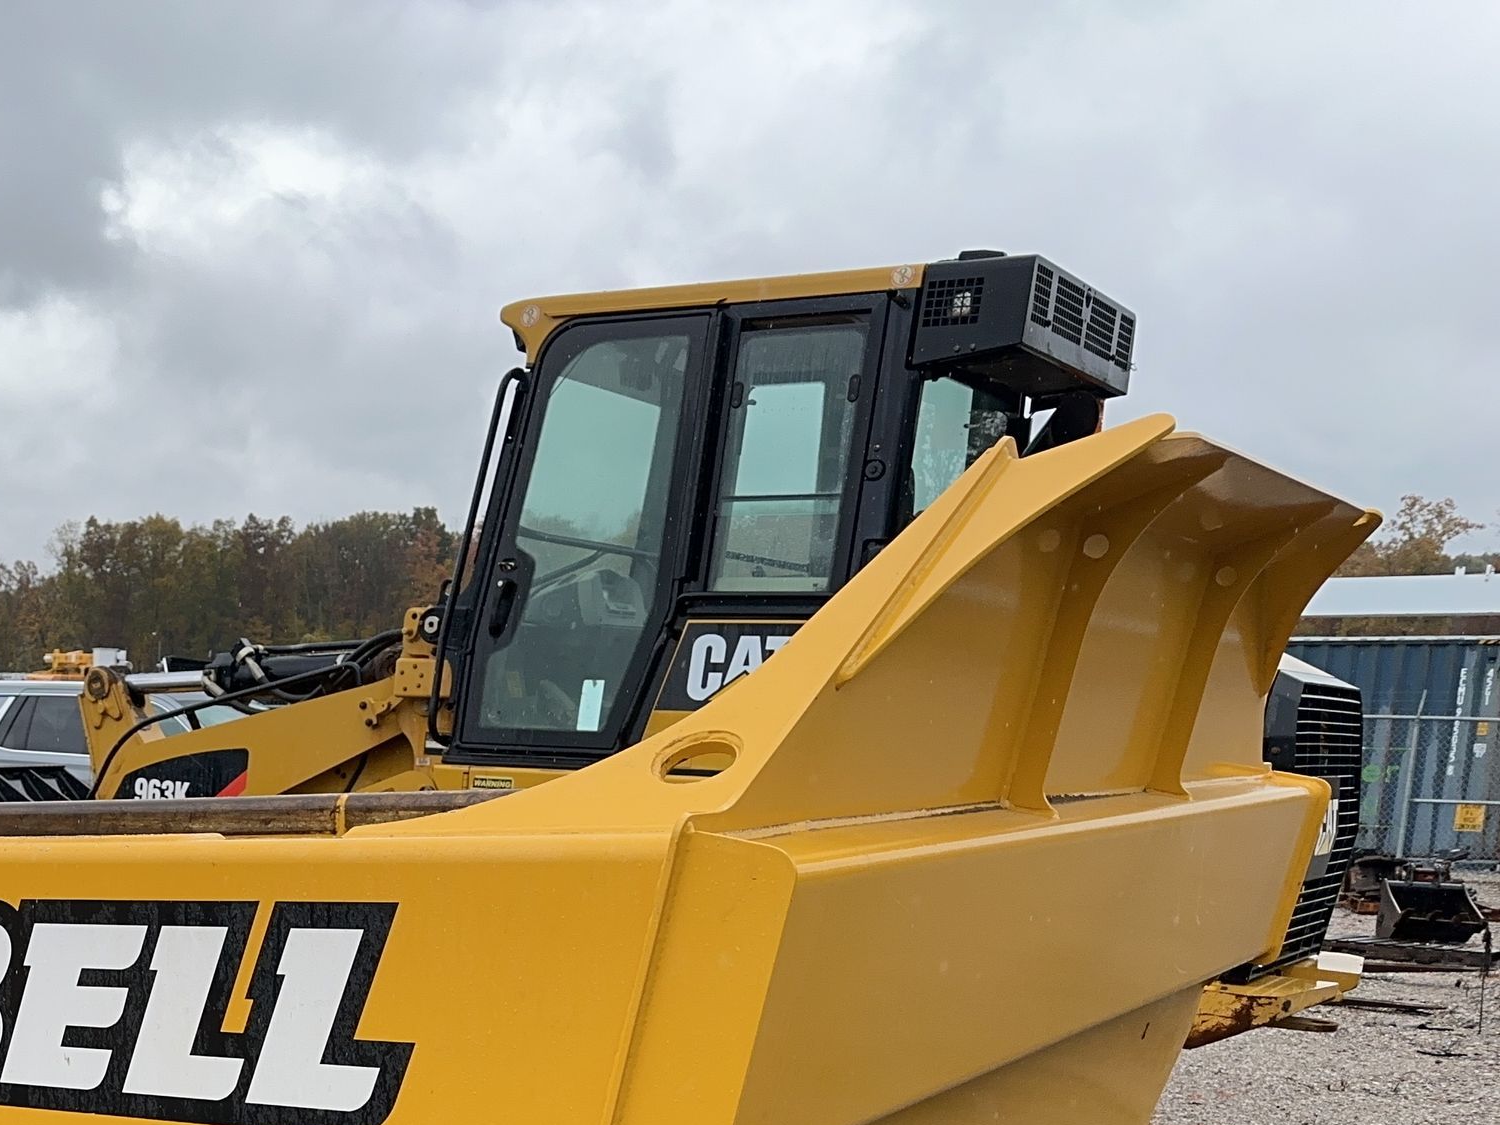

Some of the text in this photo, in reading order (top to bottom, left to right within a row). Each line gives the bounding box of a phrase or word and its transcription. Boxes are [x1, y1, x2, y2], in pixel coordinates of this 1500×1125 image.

[686, 634, 792, 701] CA
[134, 777, 190, 800] 963K
[474, 780, 511, 788] WARNING
